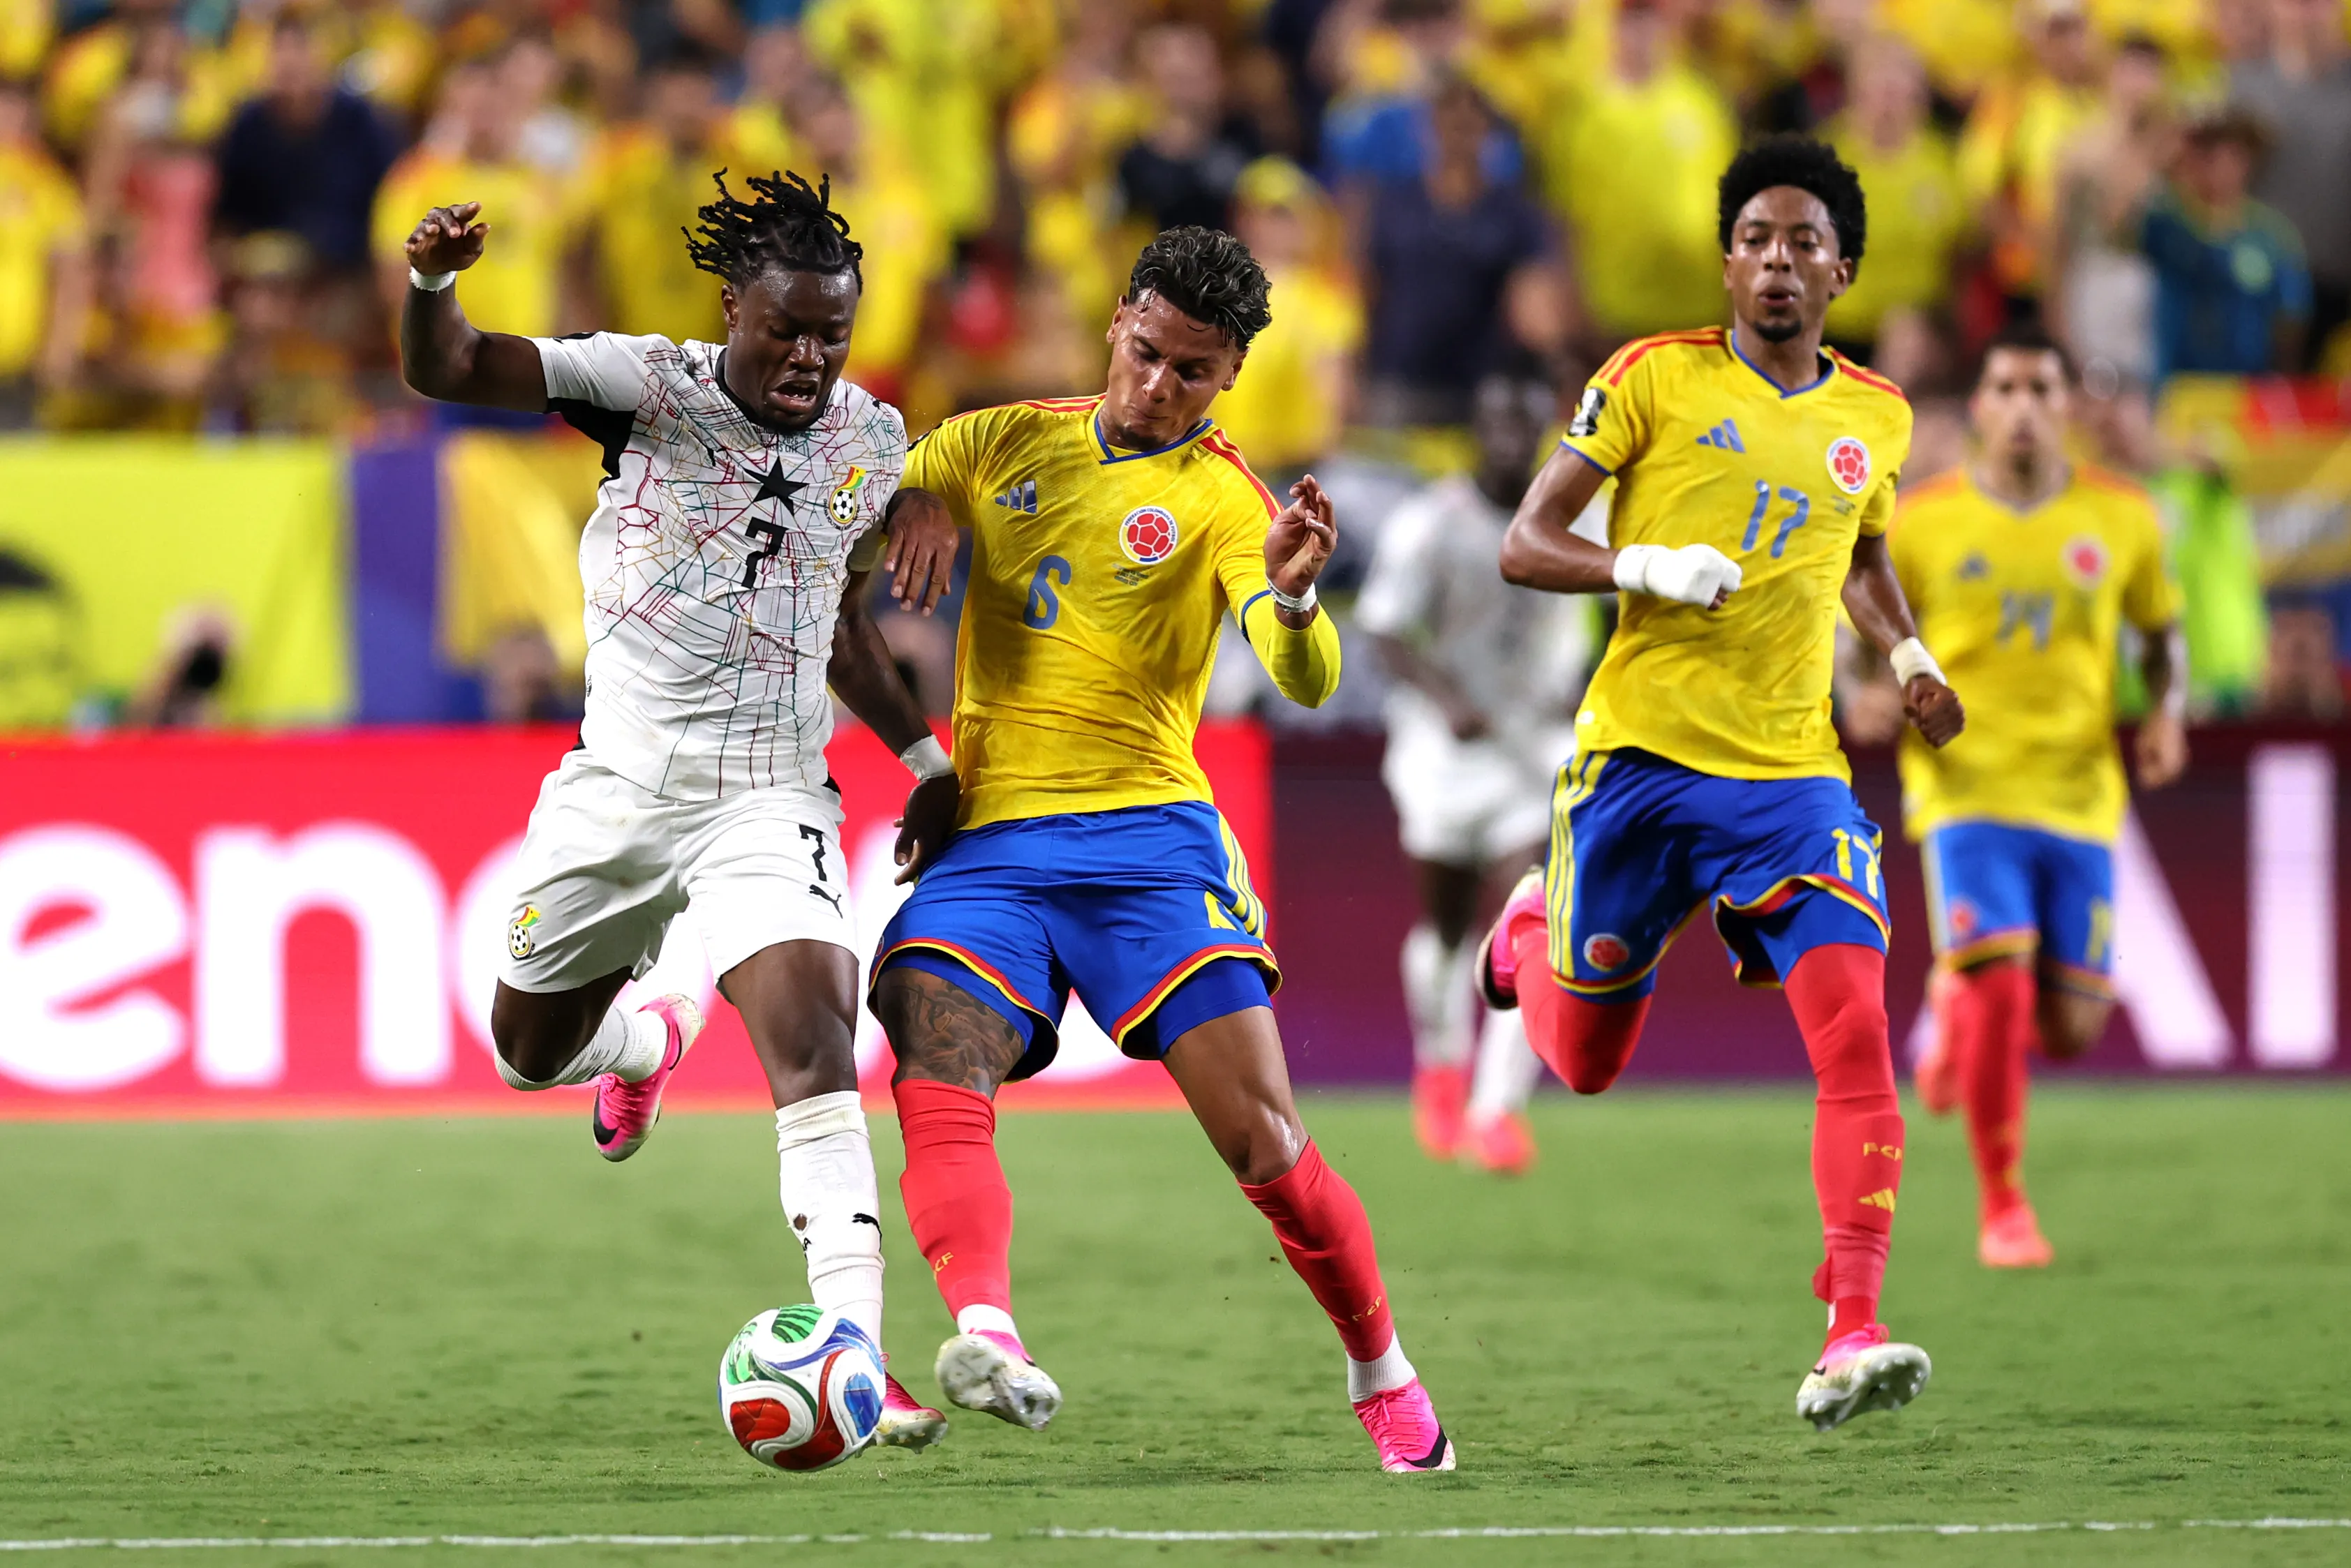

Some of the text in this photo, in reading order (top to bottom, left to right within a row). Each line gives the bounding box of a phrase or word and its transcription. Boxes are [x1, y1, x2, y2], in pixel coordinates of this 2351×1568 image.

[741, 516, 789, 590] 7
[1741, 479, 1810, 559] 17
[1023, 555, 1071, 630] 6
[801, 823, 828, 882] 7
[1831, 828, 1879, 900] 17
[934, 1251, 954, 1280] CF
